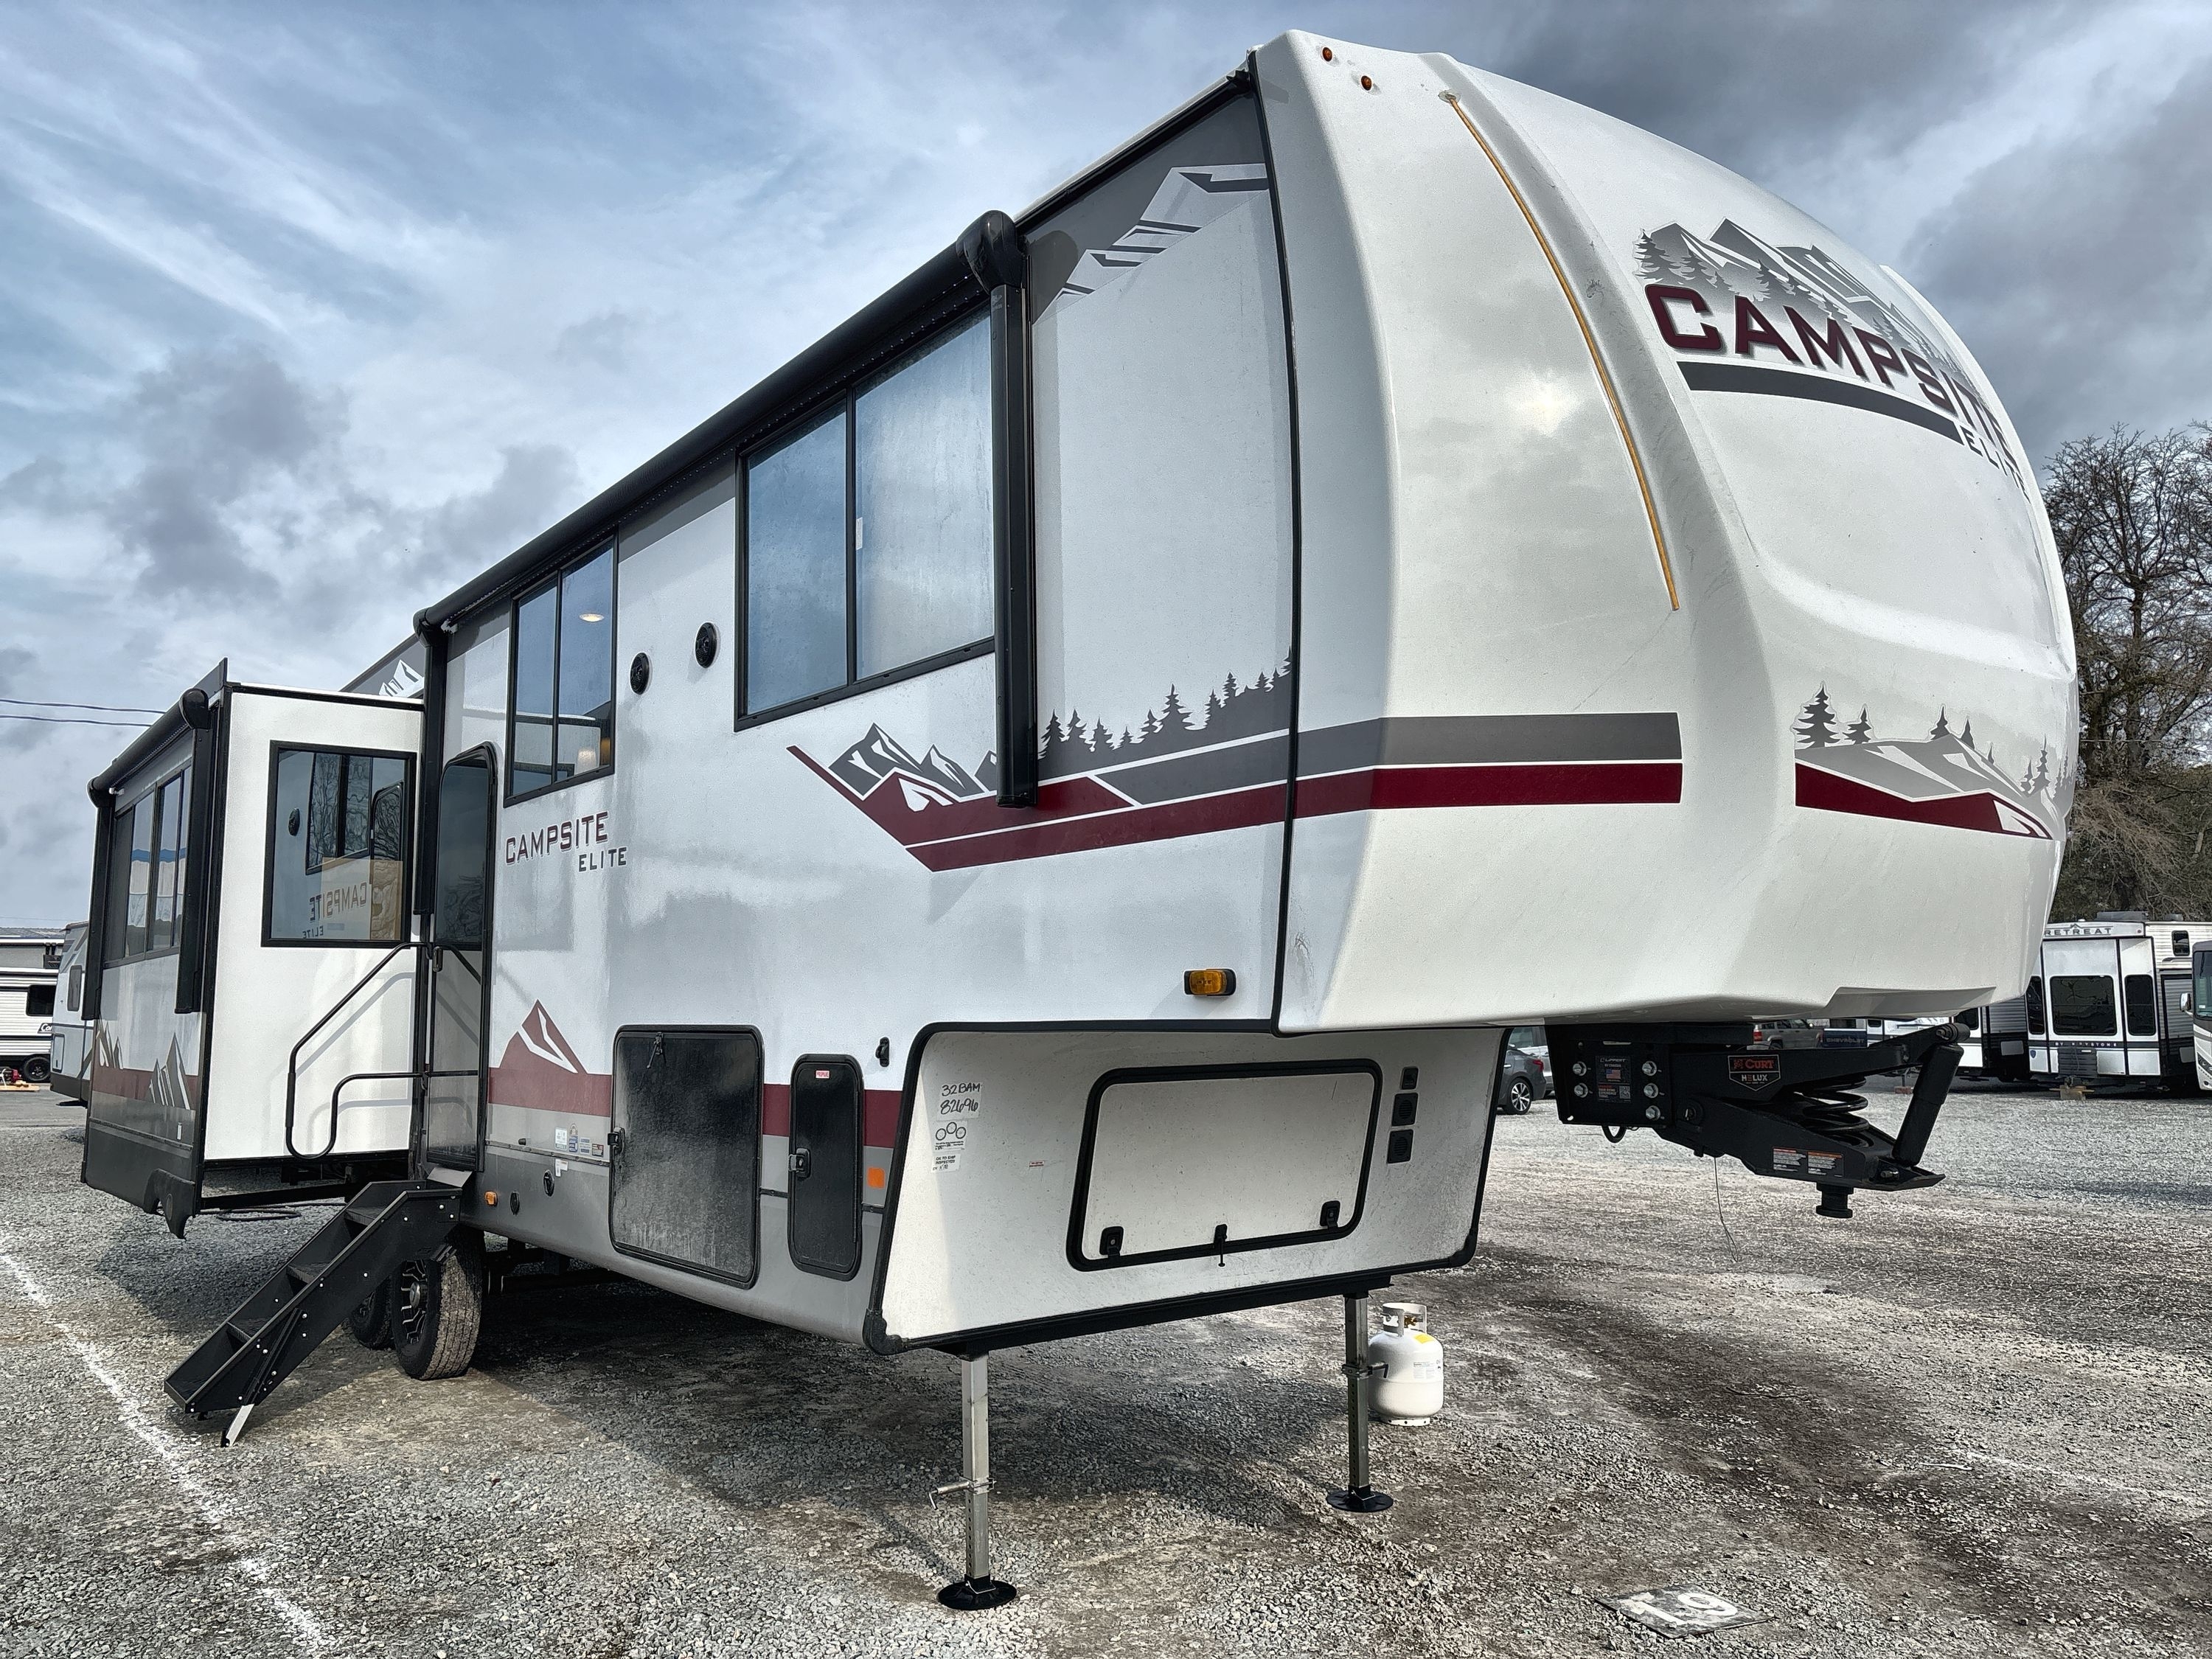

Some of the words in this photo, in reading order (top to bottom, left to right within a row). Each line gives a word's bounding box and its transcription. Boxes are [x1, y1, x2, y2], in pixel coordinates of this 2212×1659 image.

[1644, 284, 2023, 480] CAMPSITE
[1960, 425, 2031, 504] ELITE
[506, 811, 608, 864] CAMPSITE
[579, 846, 627, 872] ELITE
[2045, 928, 2112, 936] RETREAT
[1745, 1059, 1774, 1069] CURT
[942, 1082, 980, 1096] 32BAM
[940, 1098, 978, 1115] 82696
